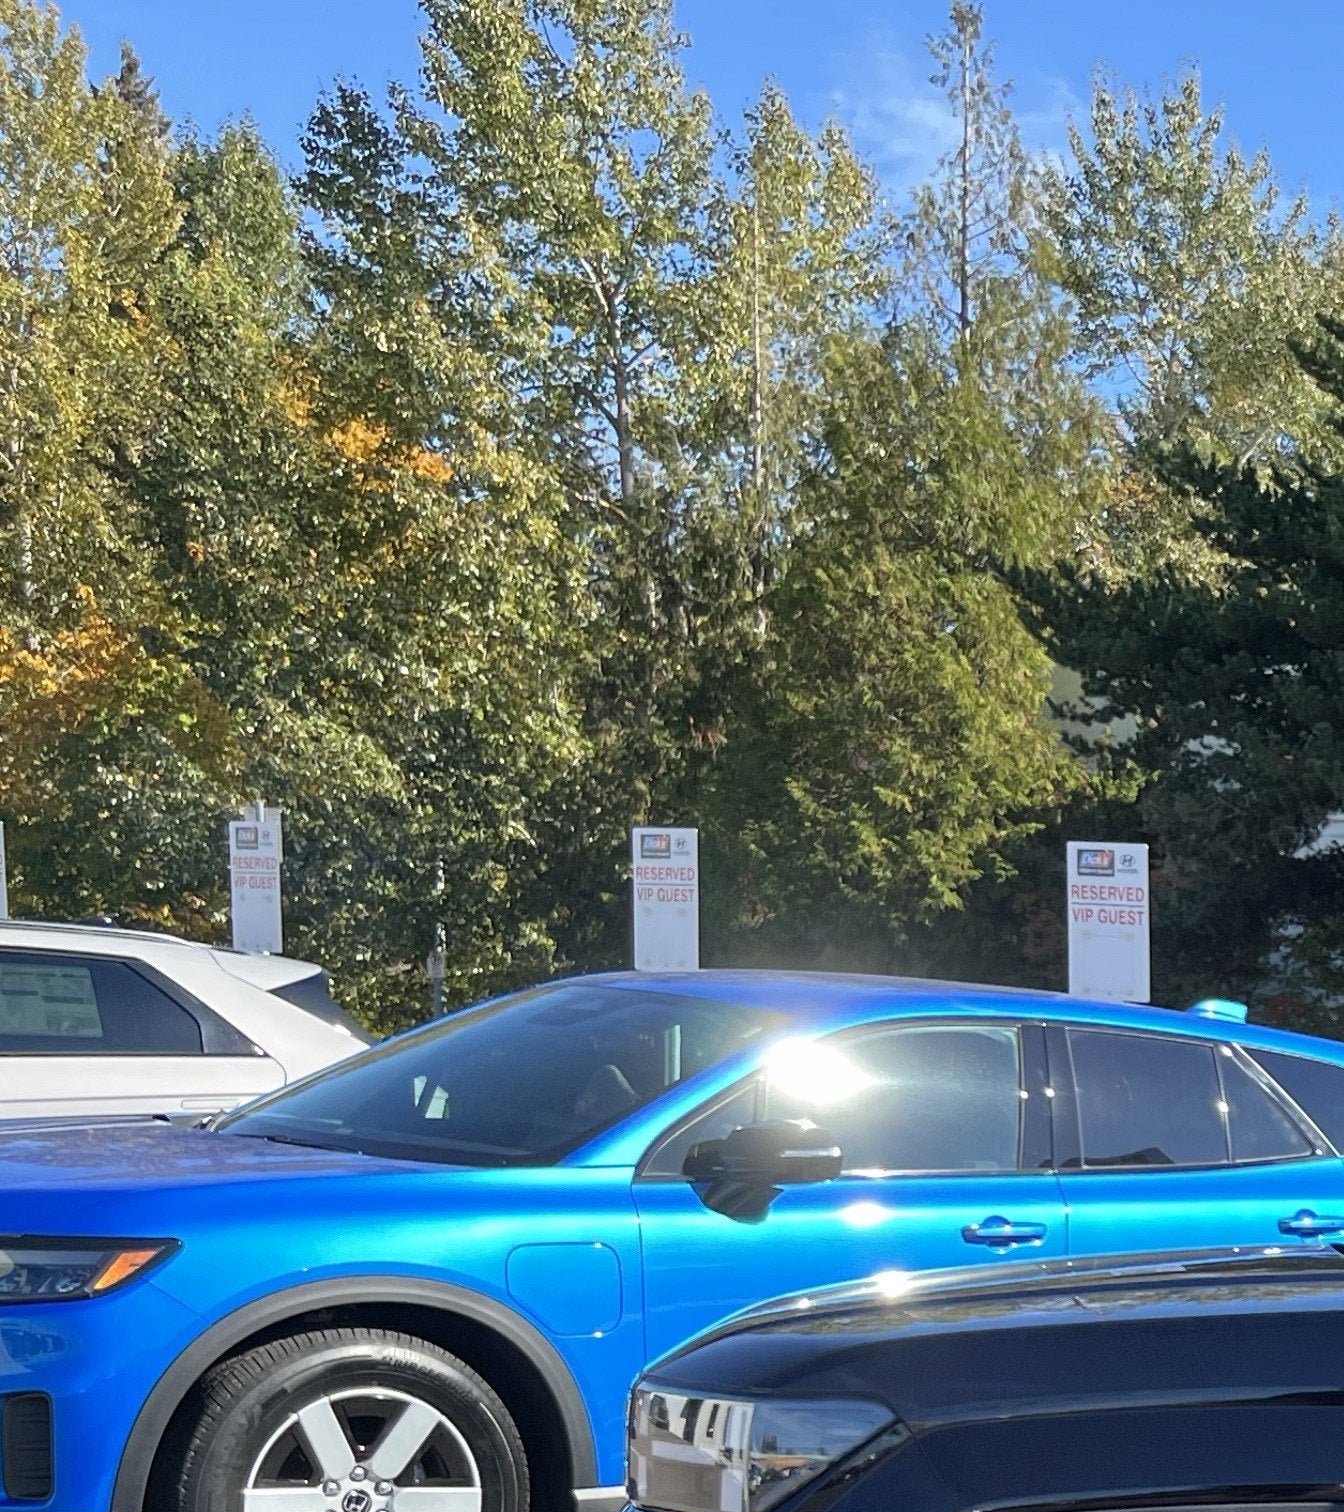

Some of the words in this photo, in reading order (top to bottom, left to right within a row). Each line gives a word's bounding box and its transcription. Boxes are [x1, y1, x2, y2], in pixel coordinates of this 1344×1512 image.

[233, 856, 277, 870] RESERVED
[636, 866, 695, 881] RESERVED
[234, 876, 247, 888] VIP
[249, 876, 276, 889] GUEST
[637, 887, 654, 901] VIP
[657, 888, 695, 902] GUEST
[1071, 884, 1144, 902] RESERVED
[1072, 909, 1093, 923] VIP
[1098, 909, 1144, 925] GUEST
